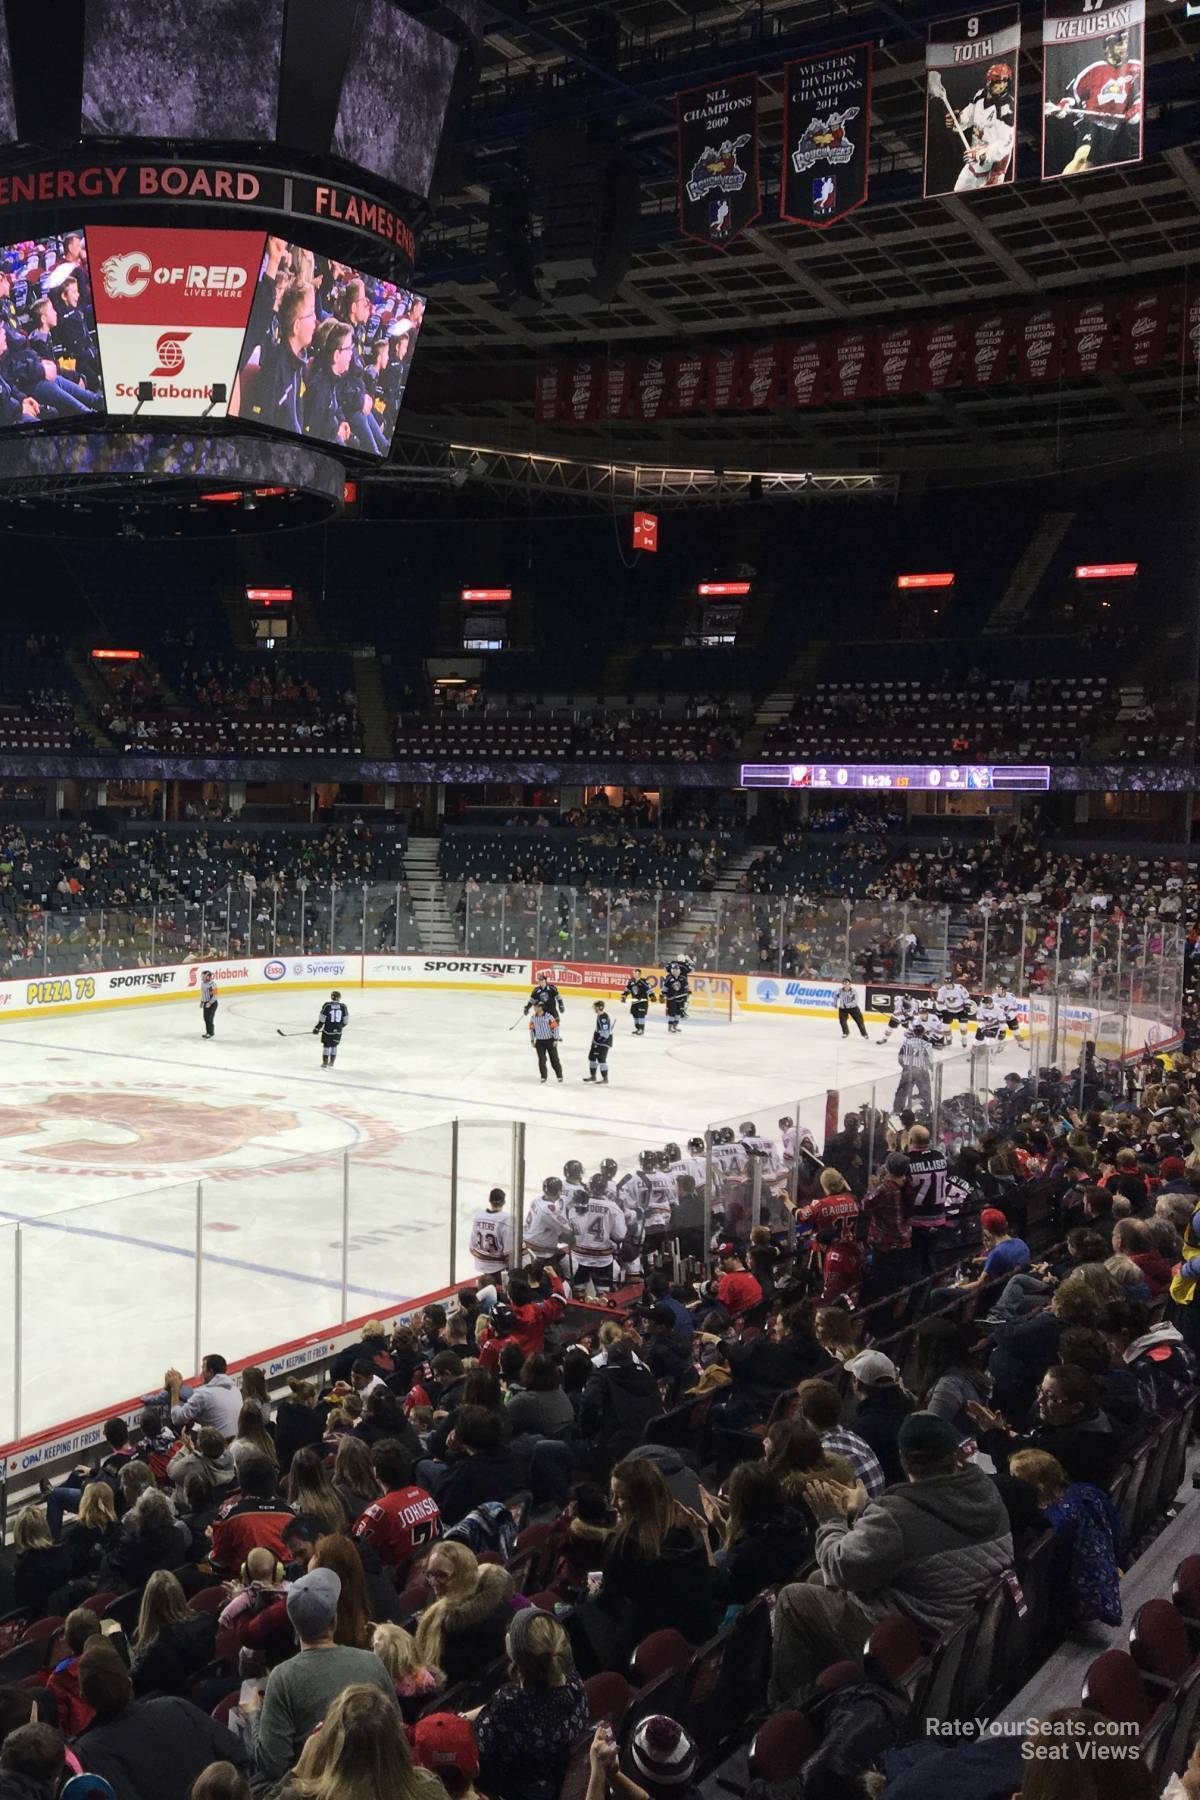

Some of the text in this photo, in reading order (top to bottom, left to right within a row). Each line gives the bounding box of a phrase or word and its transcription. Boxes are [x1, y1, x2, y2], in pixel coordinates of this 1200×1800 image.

[967, 17, 979, 37] 9
[1056, 5, 1133, 39] KELUSKY
[953, 38, 992, 61] TOTH
[800, 55, 856, 75] WESTERN
[801, 68, 855, 88] DIVISION
[706, 89, 730, 103] NLL
[792, 79, 863, 103] CHAMPIONS
[683, 96, 752, 122] CHAMPIONS
[814, 97, 838, 110] 2014
[706, 116, 729, 130] 2009
[139, 167, 260, 201] BOARD
[315, 185, 393, 240] FLAMES
[154, 267, 184, 284] OF
[186, 265, 247, 289] RED
[184, 289, 242, 298] LIVES HERE
[115, 383, 213, 399] Scoiabank
[819, 768, 848, 785] 2 0
[862, 774, 892, 787] 16:26
[929, 768, 959, 785] 0 0
[267, 966, 283, 976] Esso
[306, 964, 345, 976] Synergy
[387, 964, 412, 972] TELUS
[424, 961, 528, 977] SPORTSNET
[110, 972, 176, 989] SPORTSNET
[584, 976, 609, 985] BETTER
[27, 978, 95, 1004] PIZZA 73
[822, 1203, 859, 1217] GAUDREA
[588, 1217, 604, 1242] 4
[269, 1347, 328, 1375] OPA! KEEPING IT FRESH
[22, 1429, 101, 1469] OPA! KEEPING IT FRESH
[399, 1496, 440, 1528] JOHNSO
